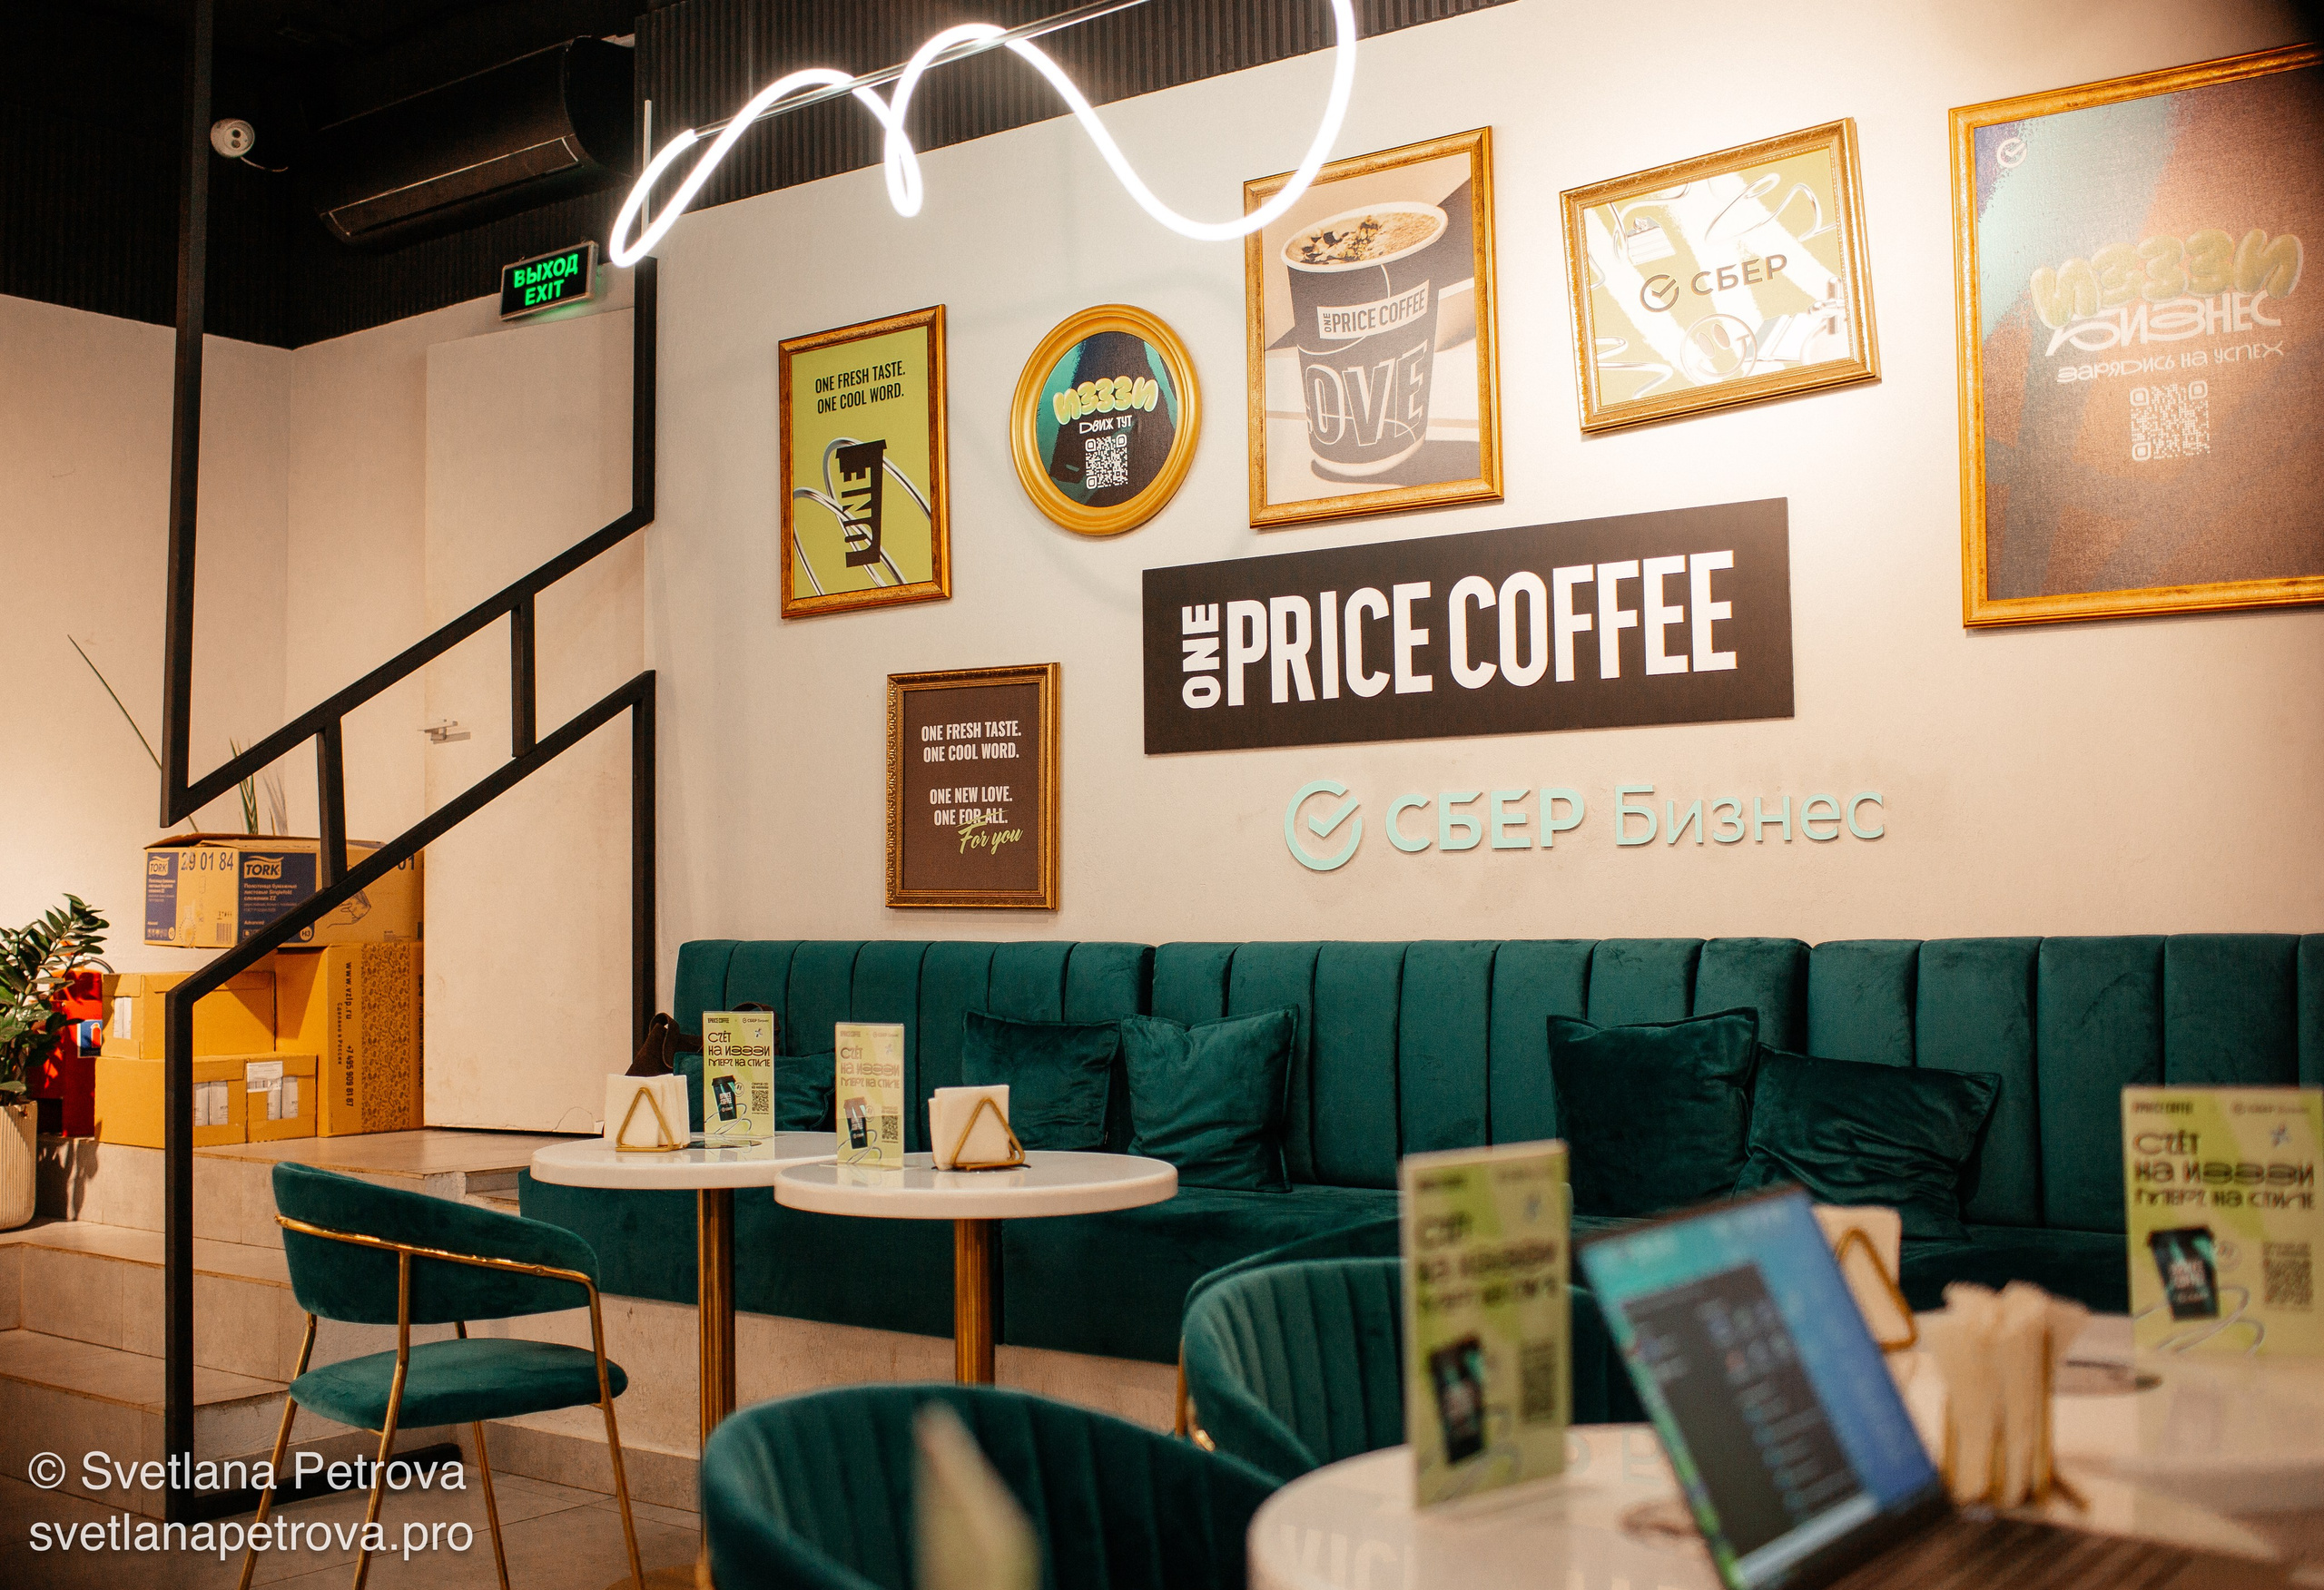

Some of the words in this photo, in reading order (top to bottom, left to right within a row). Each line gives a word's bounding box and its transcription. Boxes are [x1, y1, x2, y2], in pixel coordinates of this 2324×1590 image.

[514, 253, 578, 288] ВЫХОД
[1690, 254, 1787, 296] СБЕР
[525, 280, 565, 306] EXIT
[1323, 313, 1332, 333] ONE
[1332, 308, 1376, 333] PRICE
[1379, 289, 1426, 326] COFFEE
[815, 376, 835, 394] ONE
[838, 368, 870, 389] FRESH
[872, 360, 906, 381] TASTE.
[817, 396, 837, 414] ONE
[840, 390, 867, 409] COOL
[870, 382, 904, 403] WORD.
[1305, 339, 1428, 447] OVE
[1117, 415, 1132, 428] ТУТ
[1182, 603, 1222, 710] ONE
[1226, 581, 1433, 707] PRICE
[1448, 549, 1738, 690] COFFEE
[921, 725, 943, 741] ONE
[946, 721, 981, 741] FRESH
[984, 720, 1021, 738] TASTE.
[923, 746, 945, 762] ONE
[948, 743, 978, 761] COOL
[981, 741, 1019, 760] WORD.
[930, 788, 951, 805] ONE
[954, 787, 979, 804] NEW
[981, 785, 1013, 802] LOVE.
[934, 810, 956, 826] ONE
[959, 808, 981, 825] FOR
[985, 807, 1009, 824] ALL.
[1385, 787, 1586, 853] СБЕР
[1614, 784, 1886, 847] Бизнес
[958, 820, 990, 855] For
[990, 828, 1024, 855] you
[150, 863, 167, 872] TORK
[182, 851, 196, 870] 29
[200, 851, 214, 870] 01
[219, 851, 233, 870] 84
[246, 864, 280, 876] TORK
